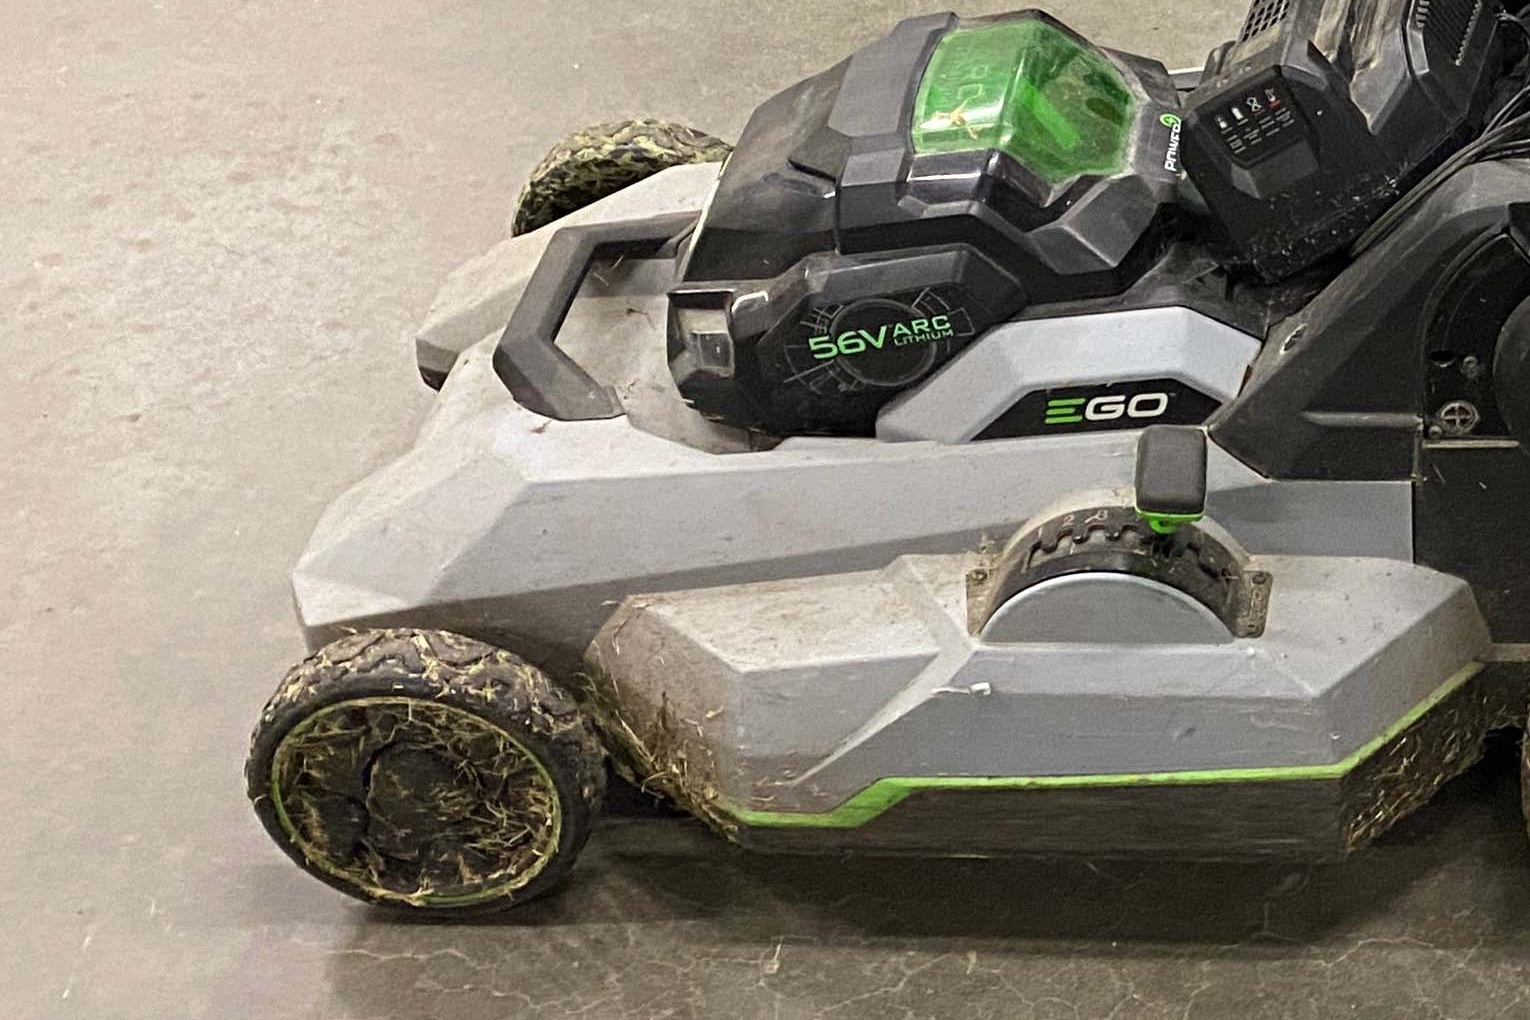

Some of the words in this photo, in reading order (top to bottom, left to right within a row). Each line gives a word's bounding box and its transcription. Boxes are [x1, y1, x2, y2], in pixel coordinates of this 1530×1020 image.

[808, 325, 887, 359] 56V
[893, 315, 951, 337] ARC
[894, 329, 954, 347] LITHIUM
[1044, 392, 1169, 424] EGO
